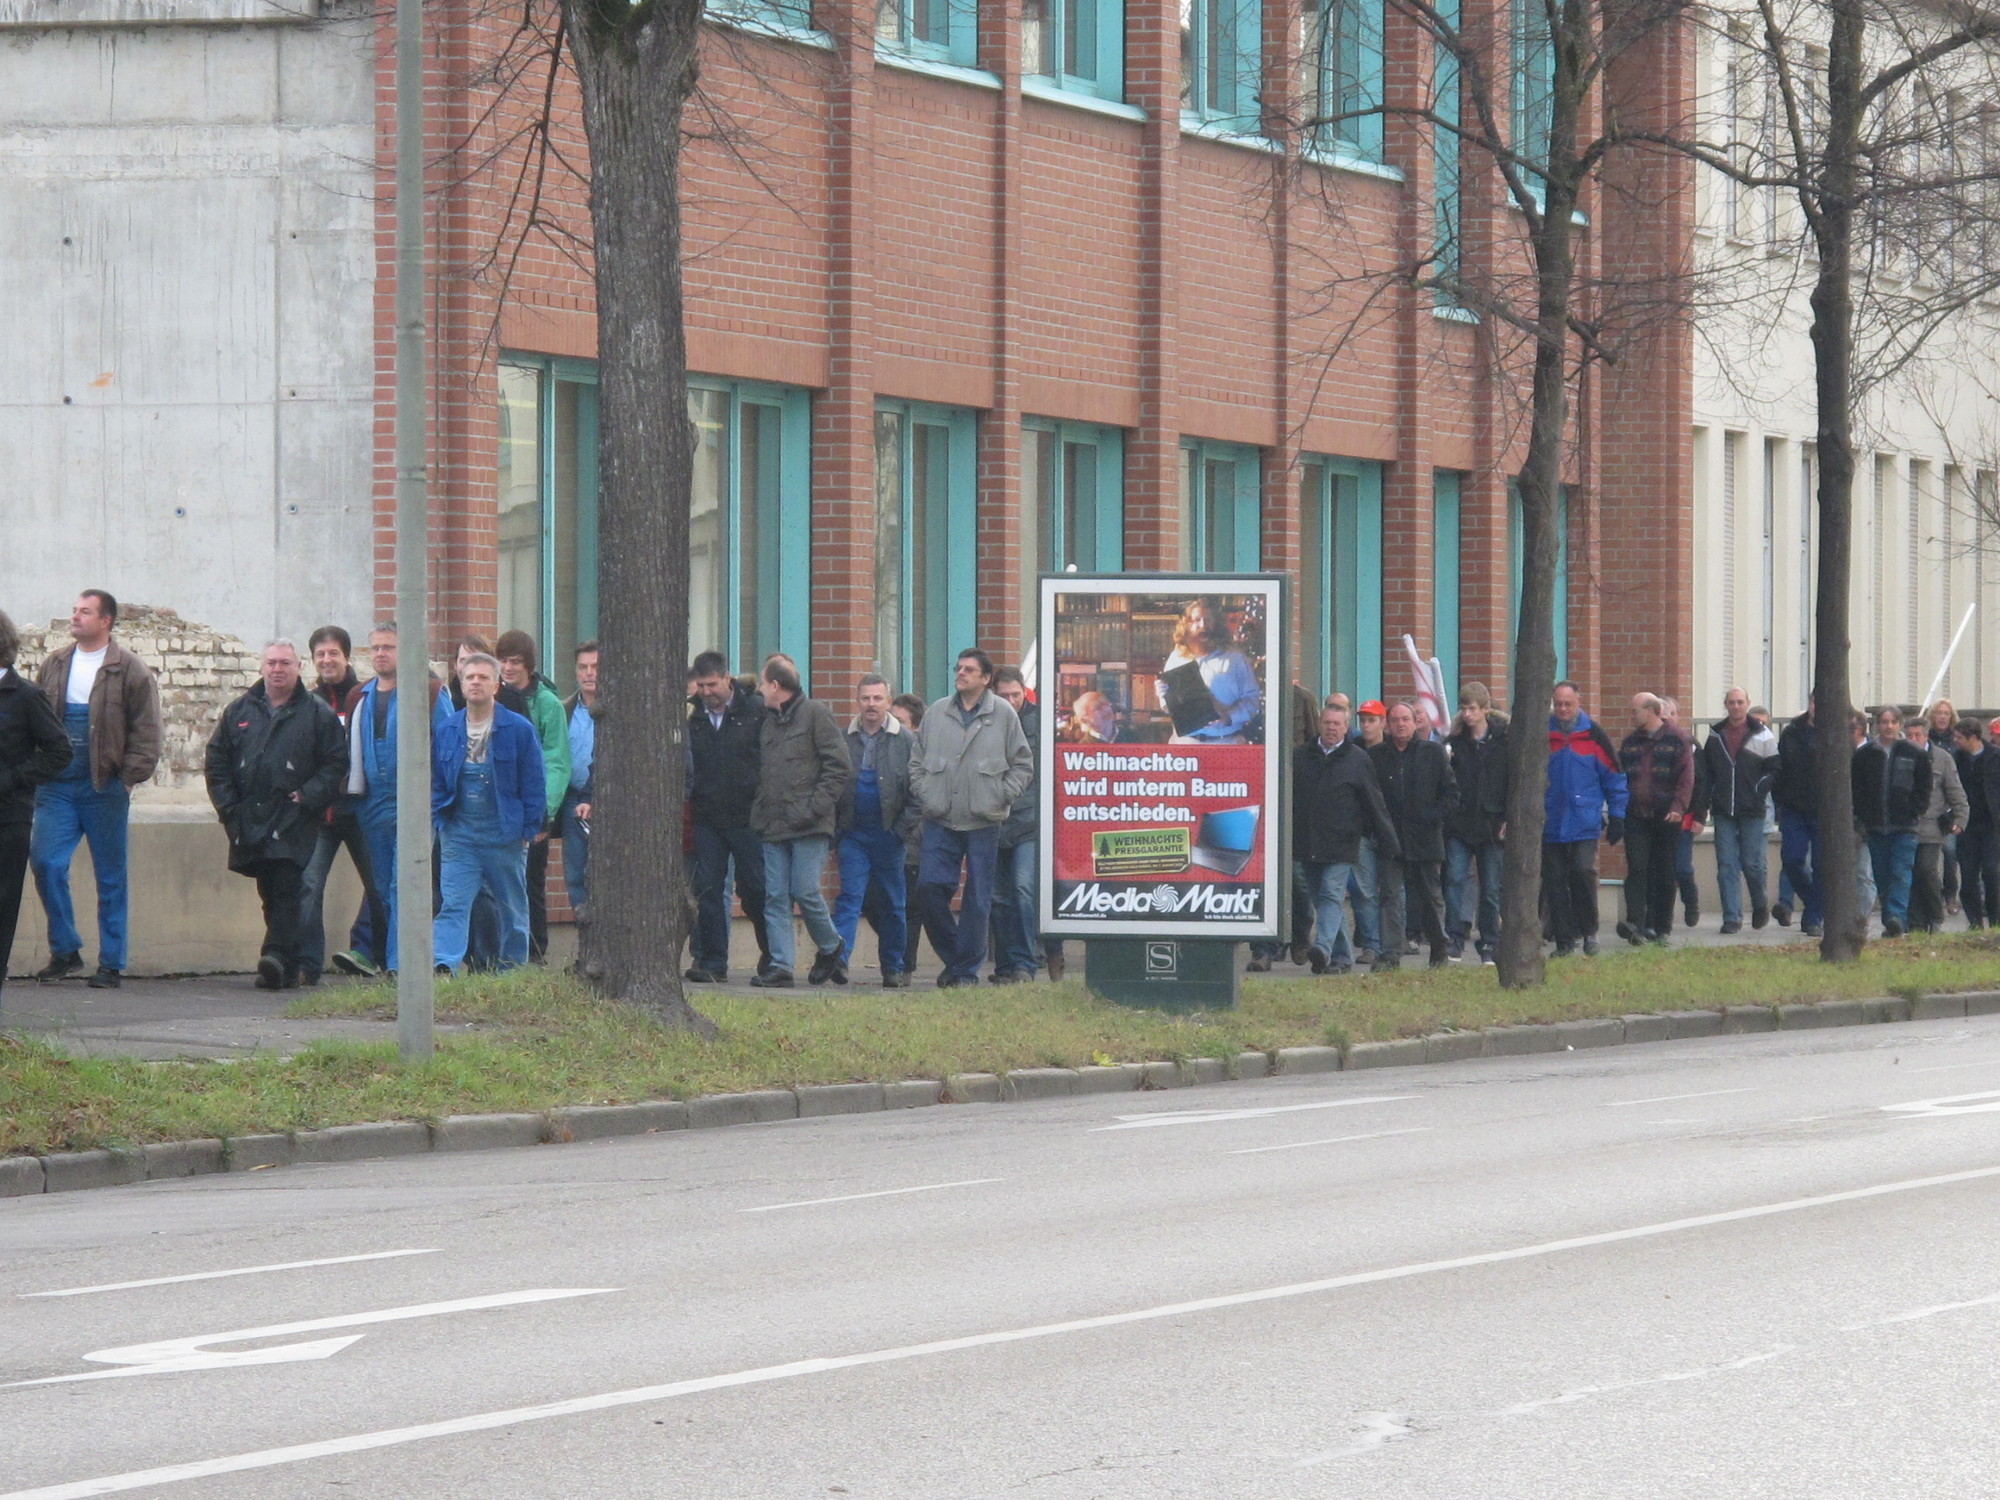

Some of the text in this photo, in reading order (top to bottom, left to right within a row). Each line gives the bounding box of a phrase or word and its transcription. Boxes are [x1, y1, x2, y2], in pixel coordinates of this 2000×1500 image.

[1063, 751, 1199, 772] Weihnachten
[1063, 777, 1248, 798] wird unterm Baum
[1063, 802, 1196, 822] entschieden.
[1114, 834, 1183, 847] WEIHNACHTS
[1114, 844, 1184, 855] PREISGARANTIE
[1058, 883, 1258, 913] Media Markt
[1150, 945, 1173, 969] S
